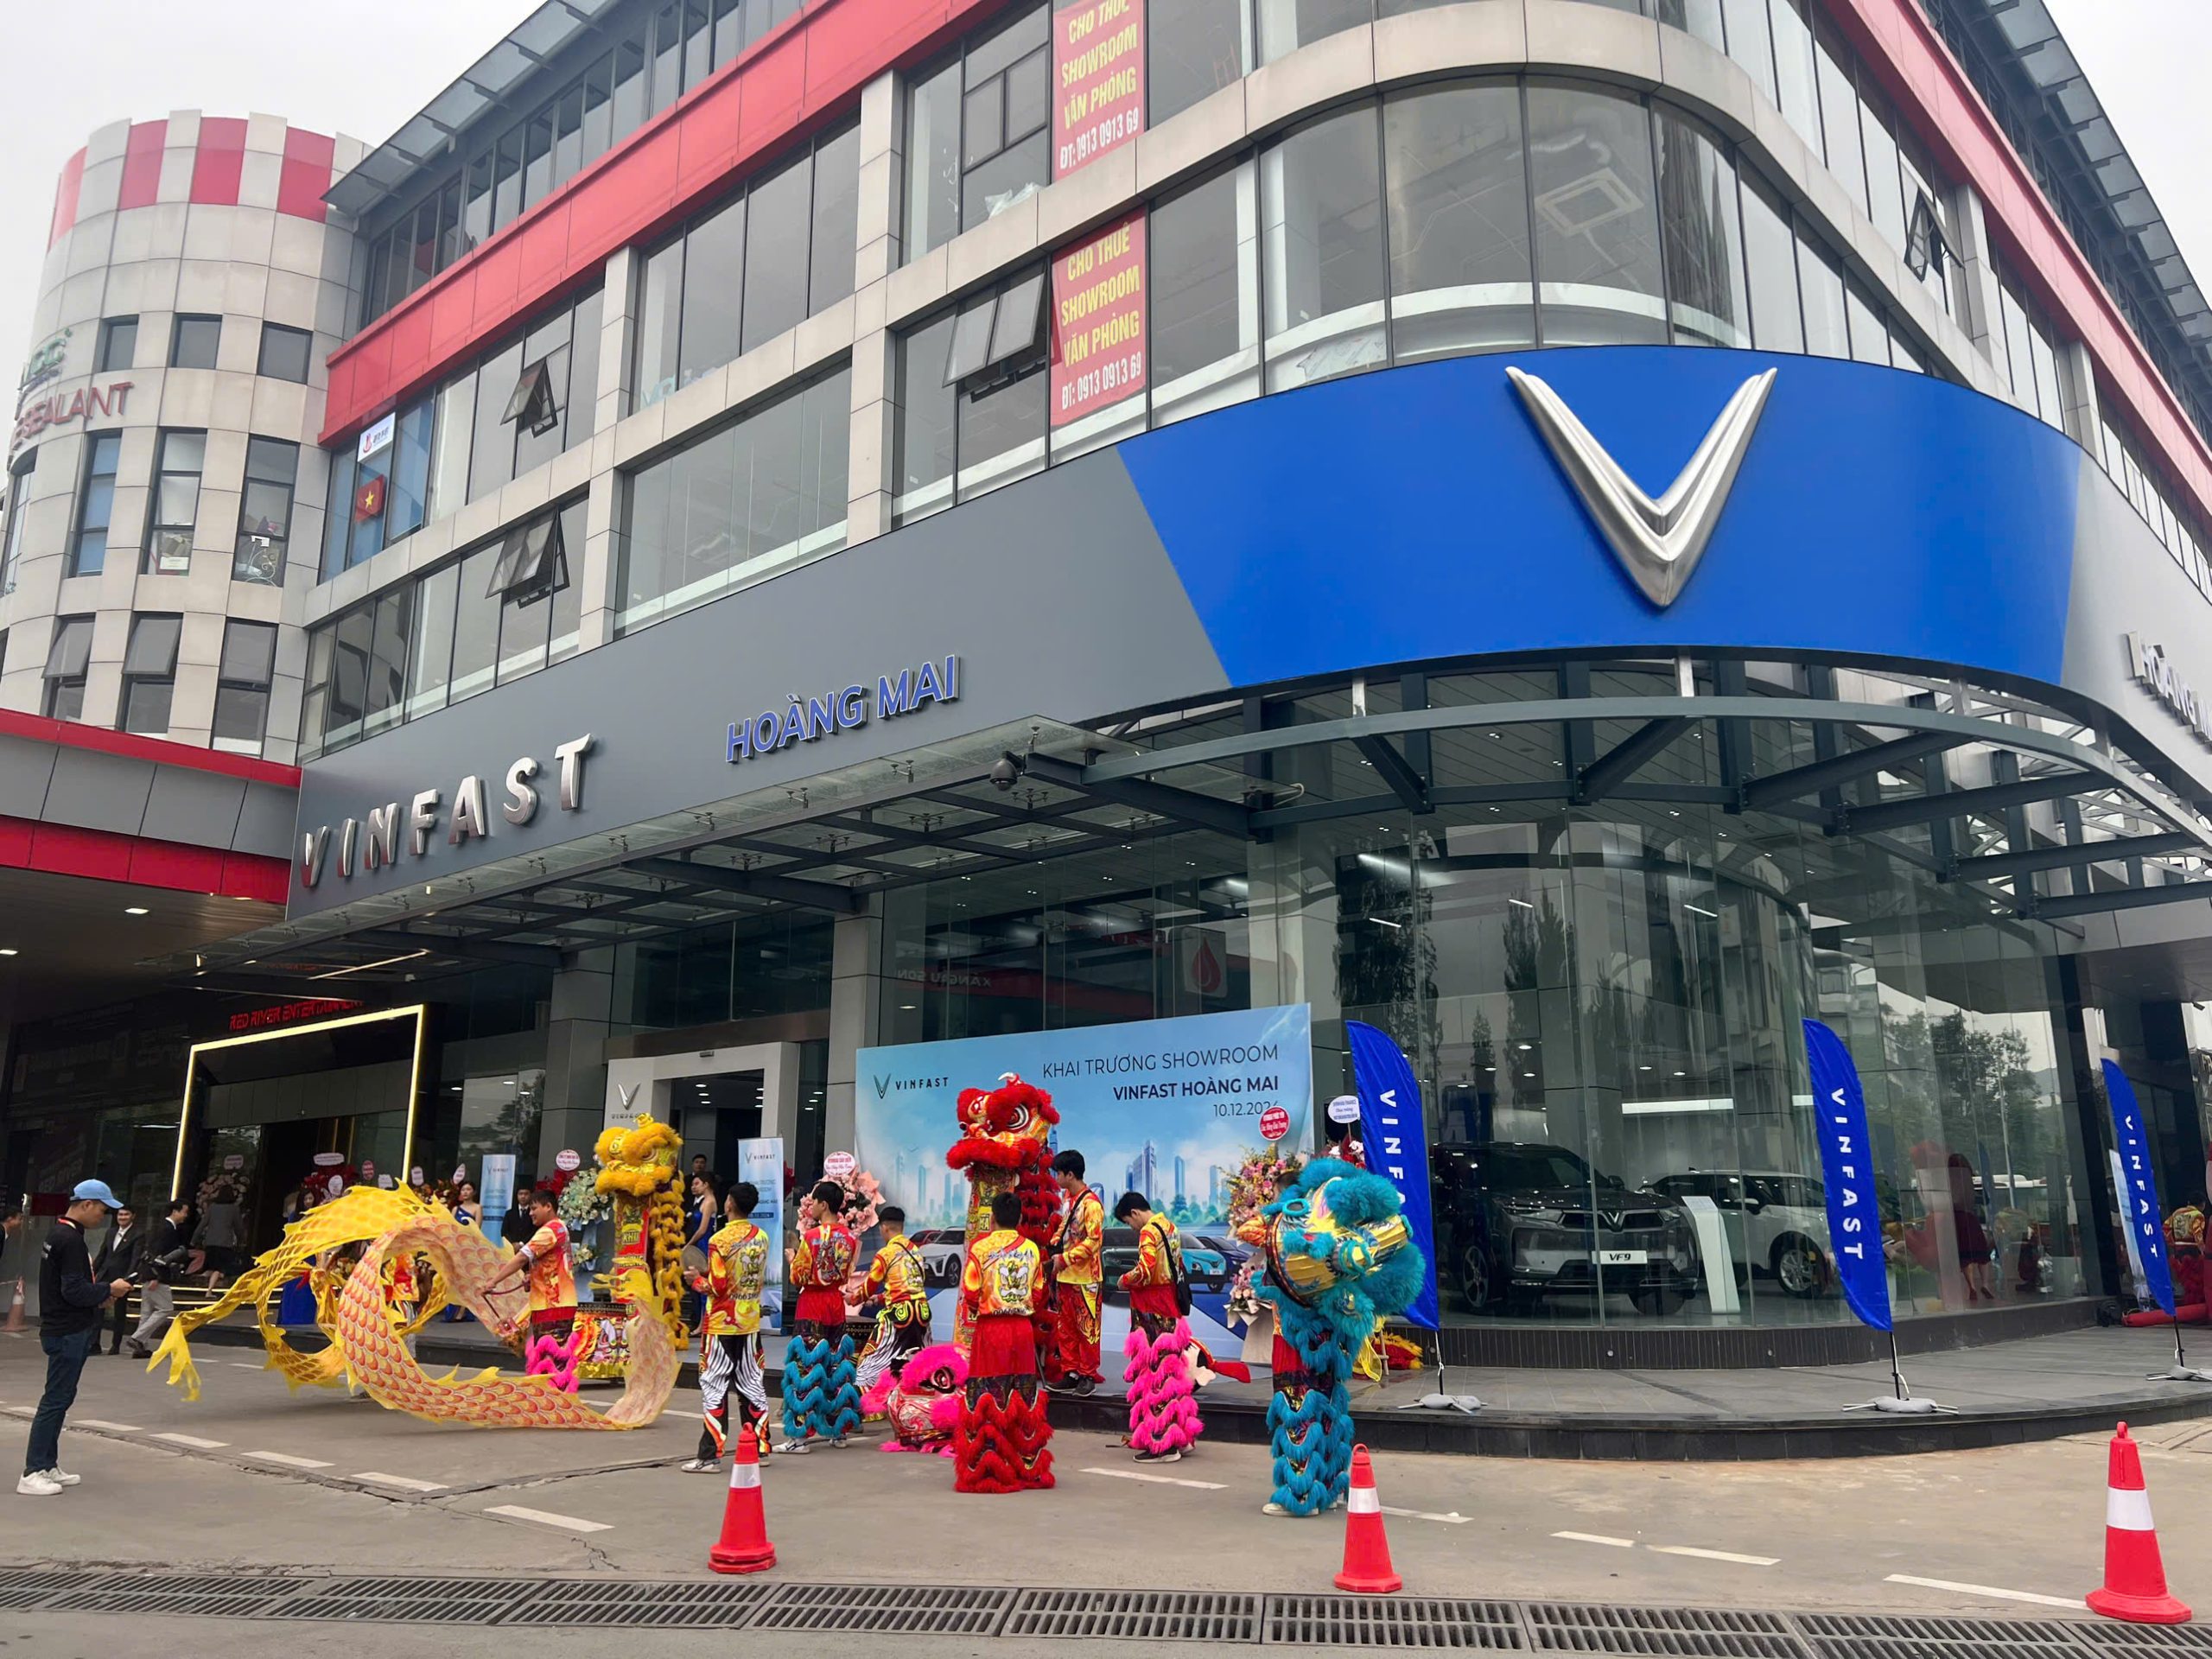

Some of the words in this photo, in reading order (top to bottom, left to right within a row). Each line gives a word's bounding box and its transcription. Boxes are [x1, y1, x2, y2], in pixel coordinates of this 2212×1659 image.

[1061, 23, 1138, 88] SHOWROOM
[1068, 10, 1095, 44] CHO
[1064, 92, 1088, 130] VĂN
[1090, 67, 1137, 112] PHÒNG
[1077, 126, 1097, 162] 0913
[1099, 113, 1123, 148] 0913
[1126, 106, 1140, 135] 69
[1067, 250, 1094, 282] CHO
[1096, 222, 1131, 266] THUÊ
[1061, 264, 1141, 327] SHOWROOM
[1064, 332, 1089, 368] VĂN
[1091, 310, 1140, 355] PHÒNG
[1077, 370, 1101, 403] 0913
[1103, 358, 1128, 391] 0913
[1130, 351, 1142, 380] 69
[725, 683, 868, 764] HOÀNG
[876, 654, 959, 720] MAI
[302, 733, 594, 888] VINFAST
[229, 1012, 250, 1031] RED
[895, 1077, 949, 1090] VINFAST
[1043, 1060, 1080, 1079] KHAI
[1161, 1043, 1279, 1070] SHOWROOM
[1113, 1083, 1178, 1102] VINFAST
[1181, 1077, 1242, 1097] HOÀNG
[1246, 1076, 1279, 1093] MAI
[1212, 1101, 1279, 1117] 10.12.202
[1831, 1088, 1863, 1261] VINFAST
[2125, 1115, 2158, 1258] VINFAST
[1609, 1253, 1631, 1262] VF9
